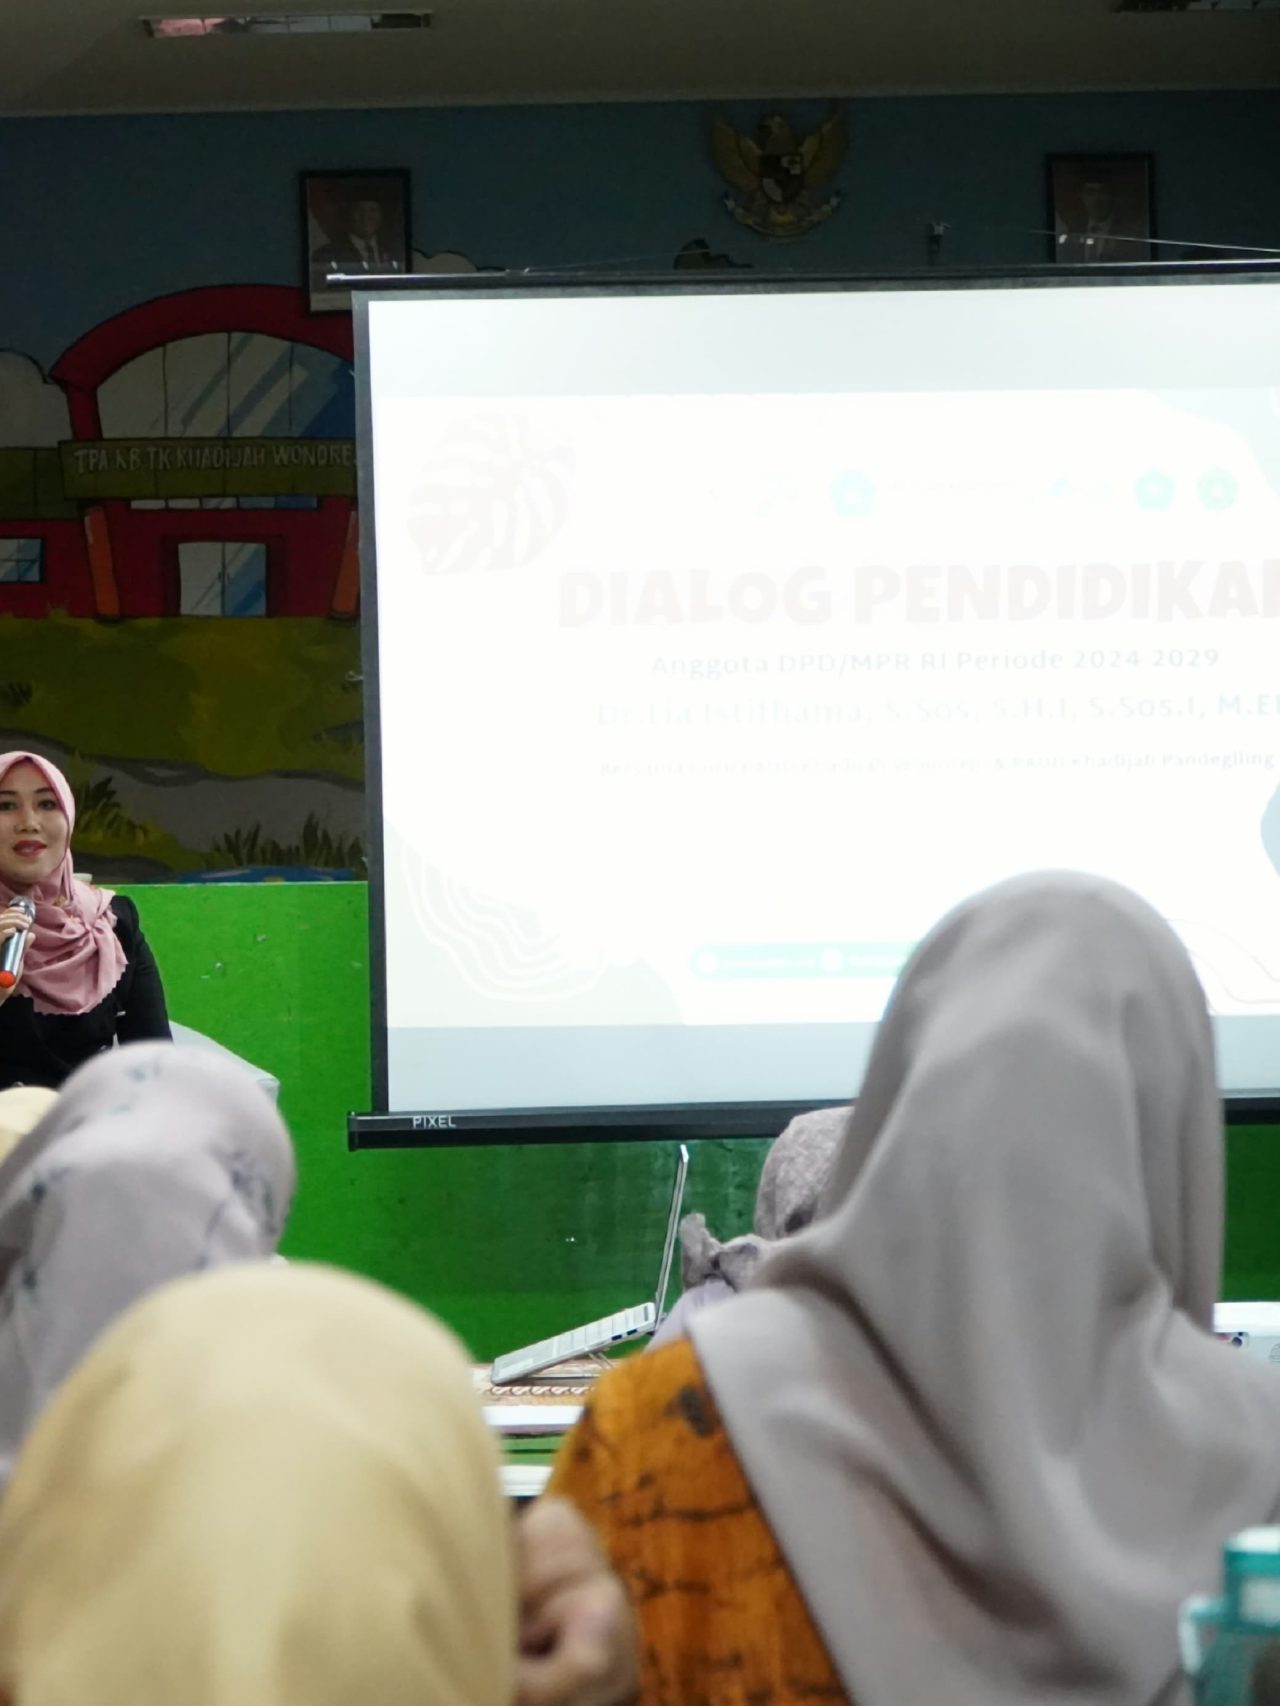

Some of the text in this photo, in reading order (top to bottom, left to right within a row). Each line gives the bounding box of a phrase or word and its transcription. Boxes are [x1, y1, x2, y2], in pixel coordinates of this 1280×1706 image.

[558, 565, 833, 628] DIALOG
[652, 648, 1219, 681] Anggota DPD/MPR RI Periode 2024 2029
[412, 1115, 456, 1129] PIXEL
